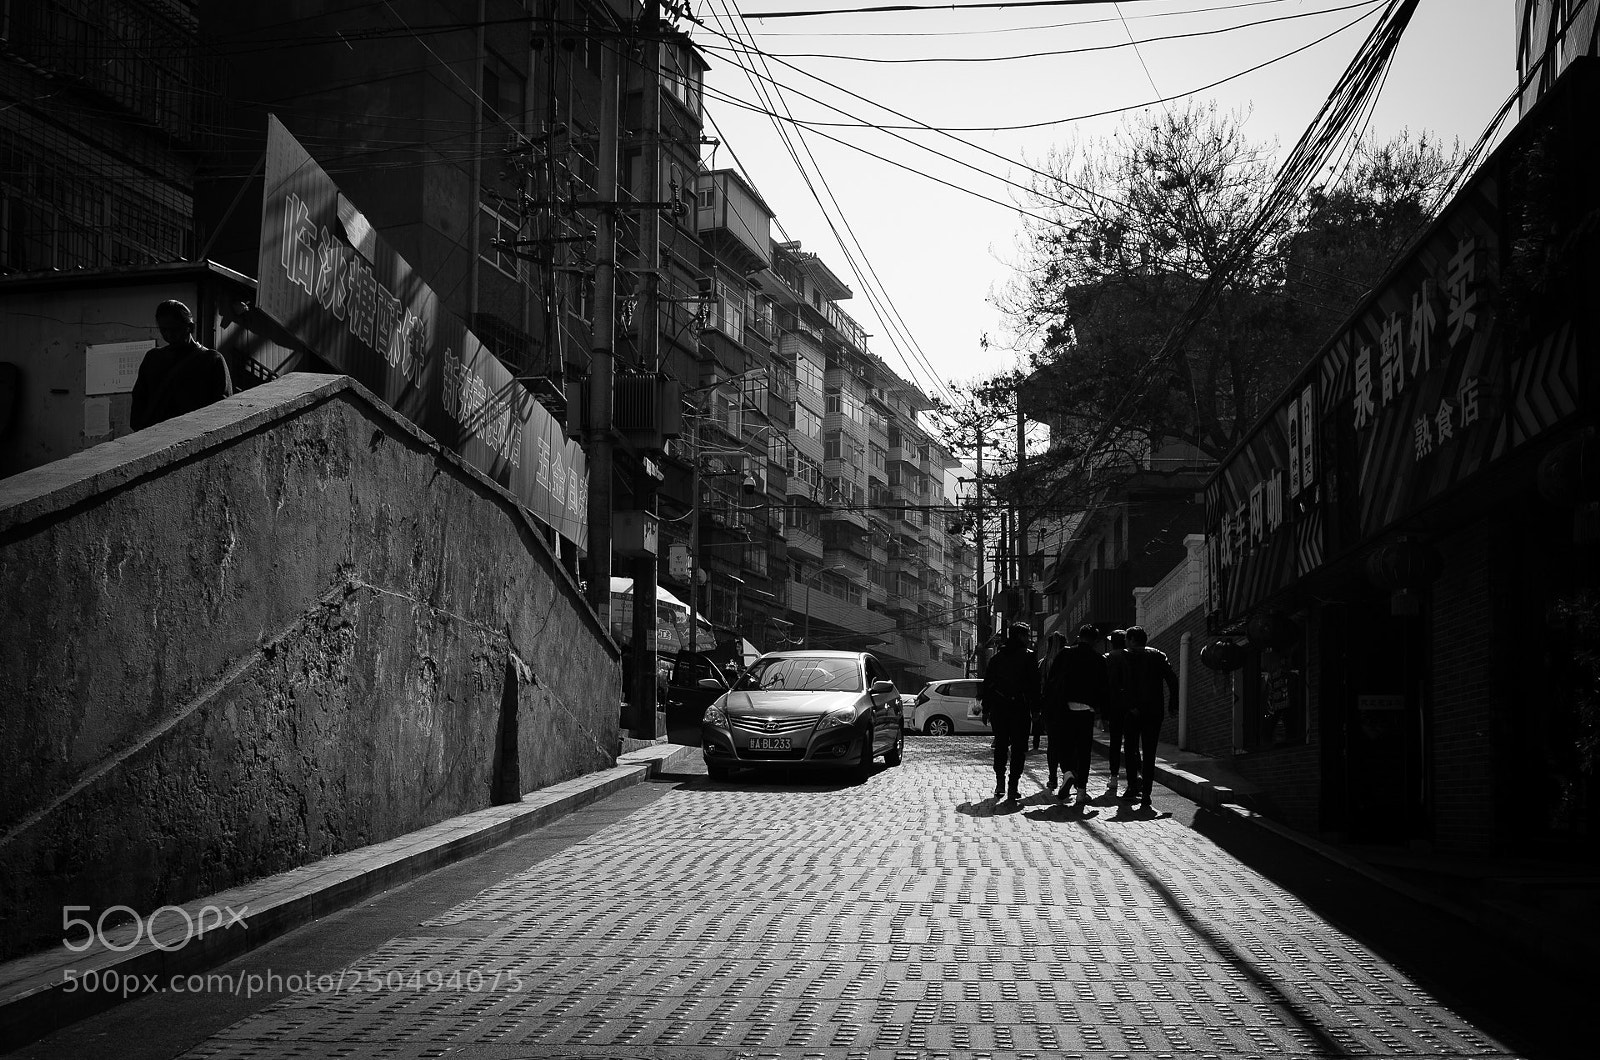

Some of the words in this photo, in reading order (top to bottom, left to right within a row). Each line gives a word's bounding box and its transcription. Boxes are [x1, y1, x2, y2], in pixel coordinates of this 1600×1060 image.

[281, 192, 425, 389] 临洮糖酥饼
[1353, 237, 1477, 431] 泉韵外卖
[1415, 376, 1480, 462] 熟食店
[1220, 468, 1282, 569] 战车网咖
